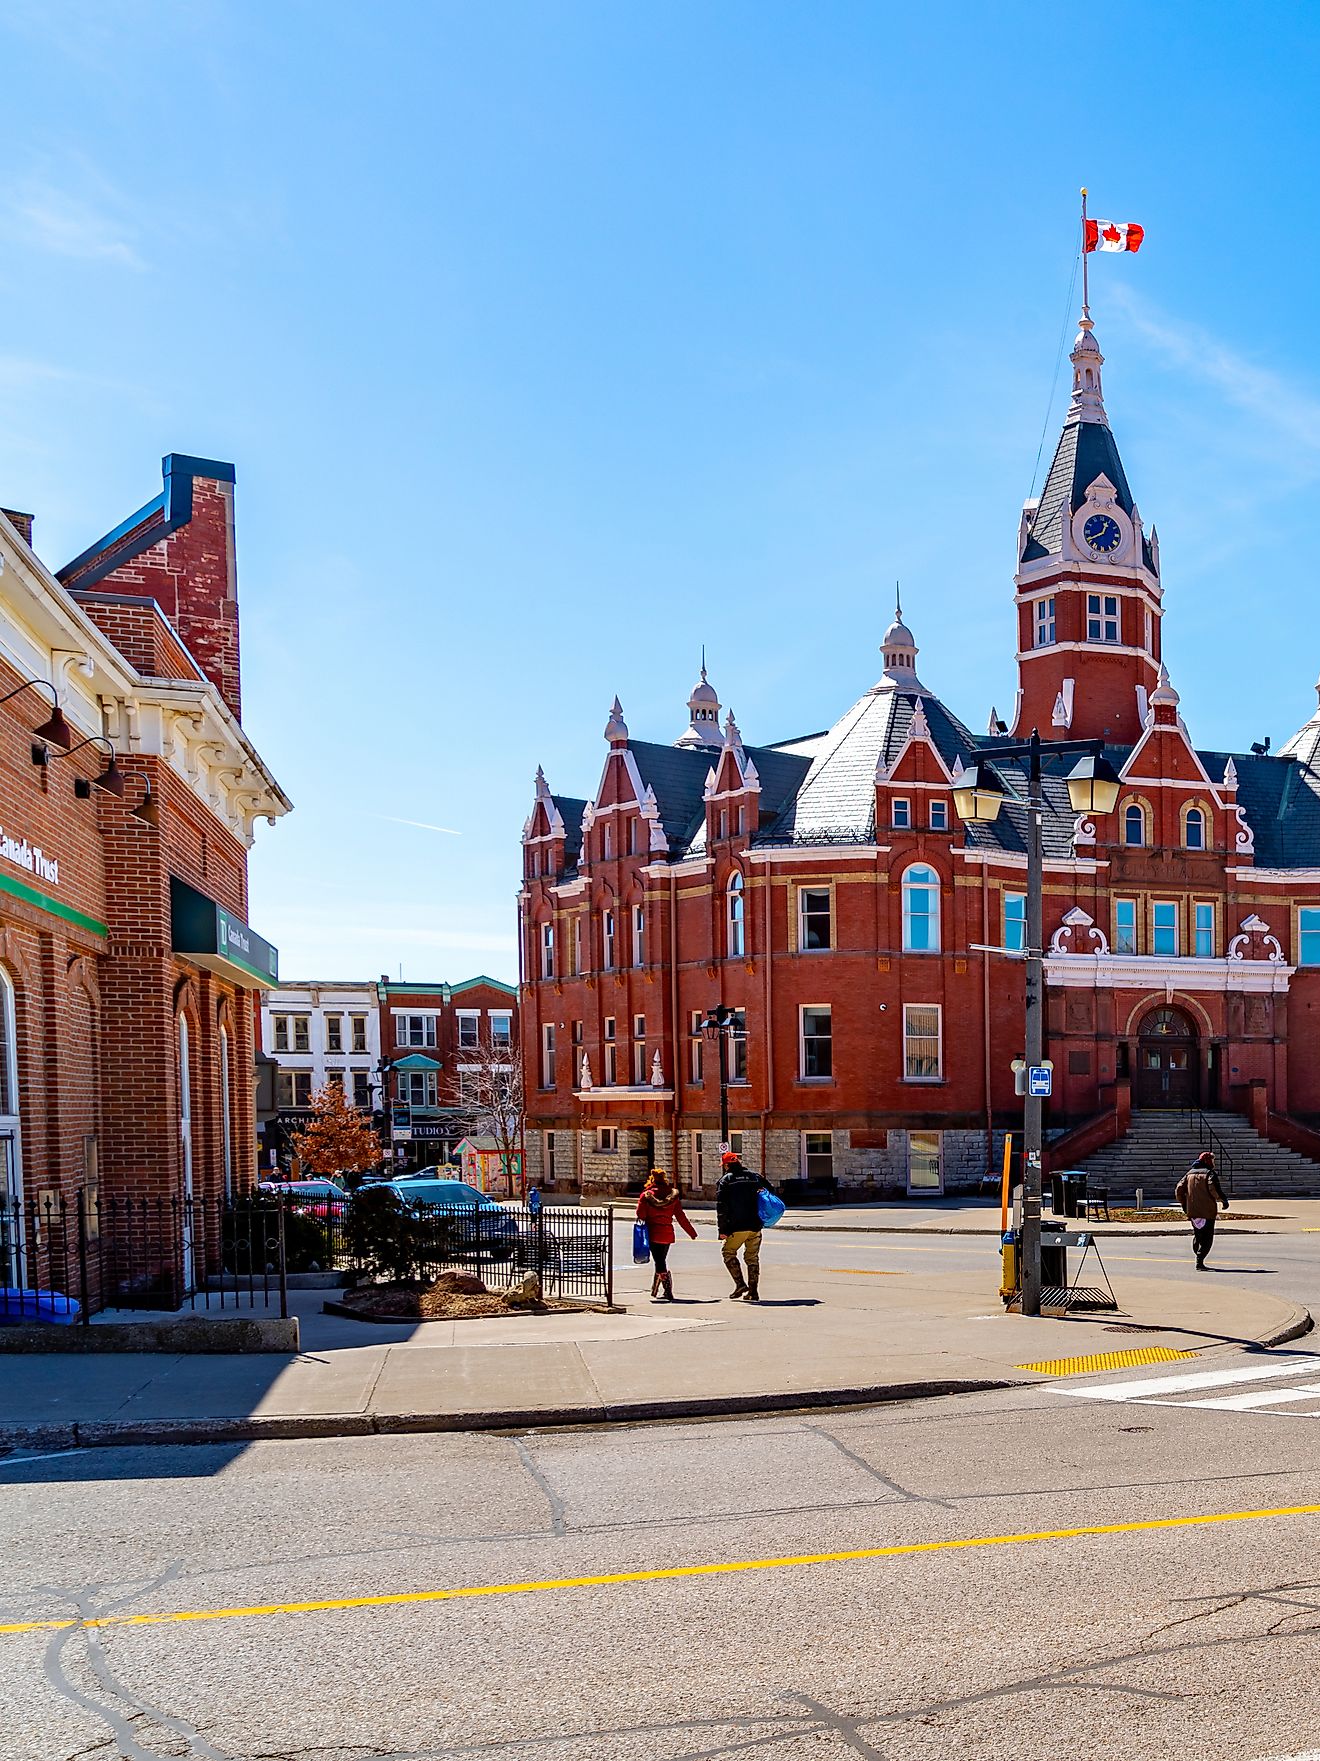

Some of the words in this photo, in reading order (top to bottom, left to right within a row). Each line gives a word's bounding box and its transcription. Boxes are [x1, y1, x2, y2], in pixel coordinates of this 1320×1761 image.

[32, 846, 59, 885] Trust
[1121, 862, 1160, 878] CITY
[1167, 863, 1212, 880] HALL
[411, 1127, 444, 1136] TUDIO
